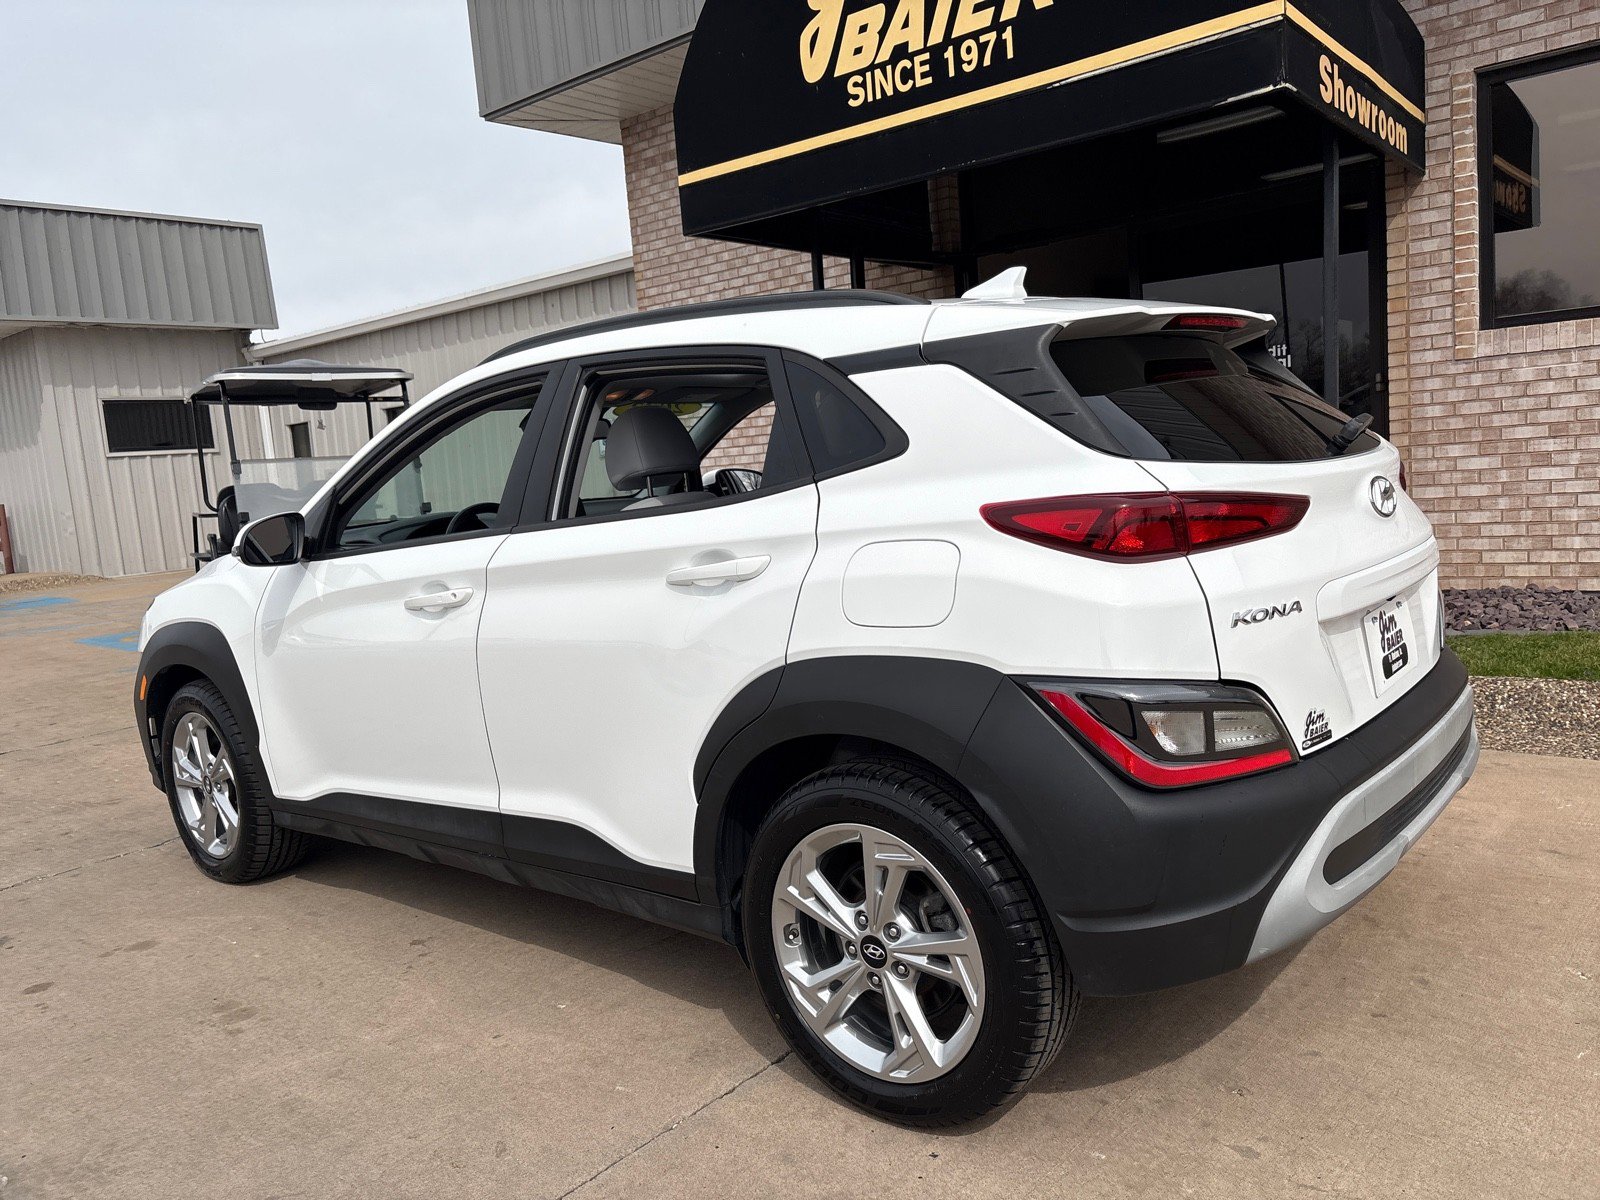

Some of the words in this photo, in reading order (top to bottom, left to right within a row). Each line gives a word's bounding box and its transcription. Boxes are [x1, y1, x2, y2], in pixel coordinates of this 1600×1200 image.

[846, 52, 933, 108] SINCE
[943, 25, 1014, 78] 1971
[1318, 54, 1408, 155] Showroom
[1230, 600, 1303, 628] KONA
[1379, 610, 1398, 654] Jim
[1386, 628, 1404, 652] BAIER
[1304, 710, 1325, 739] Jim
[1310, 721, 1329, 738] BAIER
